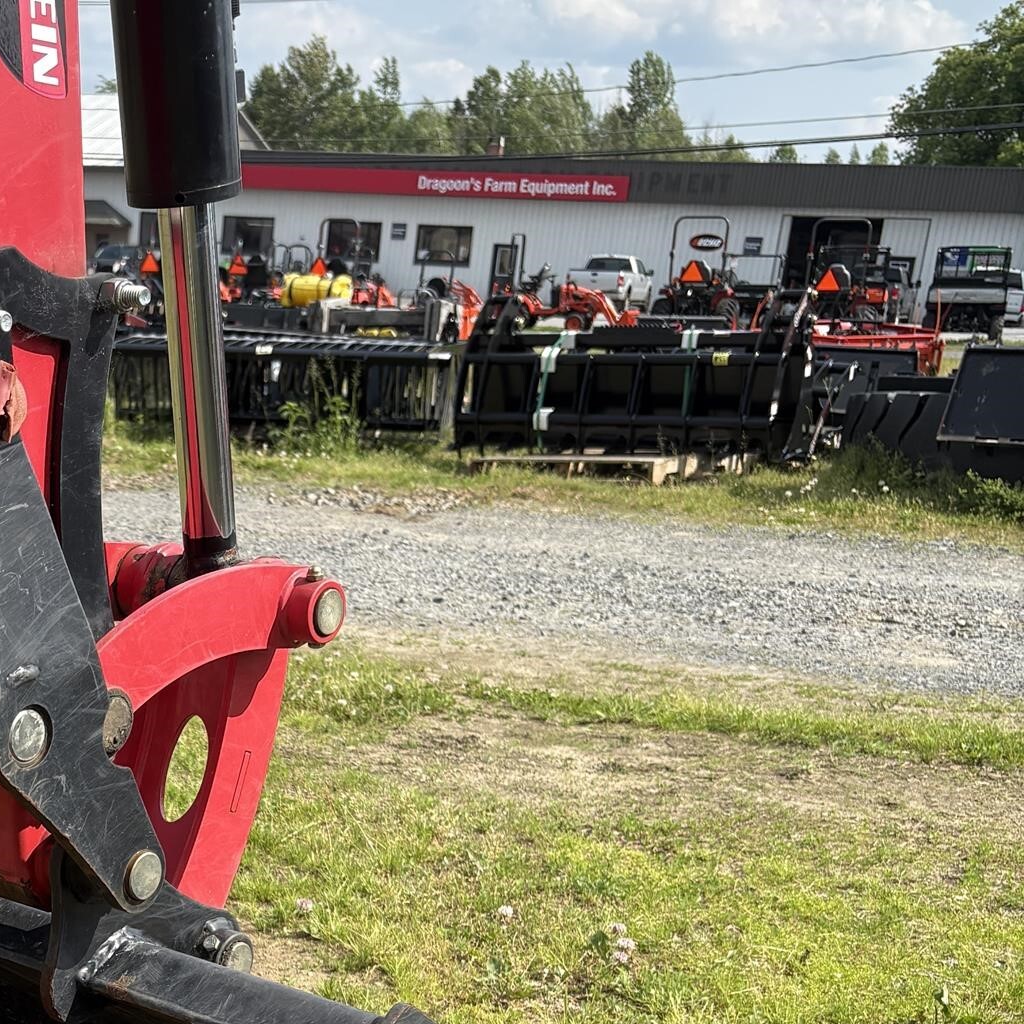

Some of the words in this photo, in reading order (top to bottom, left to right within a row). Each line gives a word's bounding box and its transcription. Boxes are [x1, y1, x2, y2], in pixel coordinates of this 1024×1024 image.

[417, 175, 481, 194] Dragoon's
[484, 178, 517, 193] Farm
[519, 179, 590, 197] Equipment
[592, 181, 617, 196] Inc.
